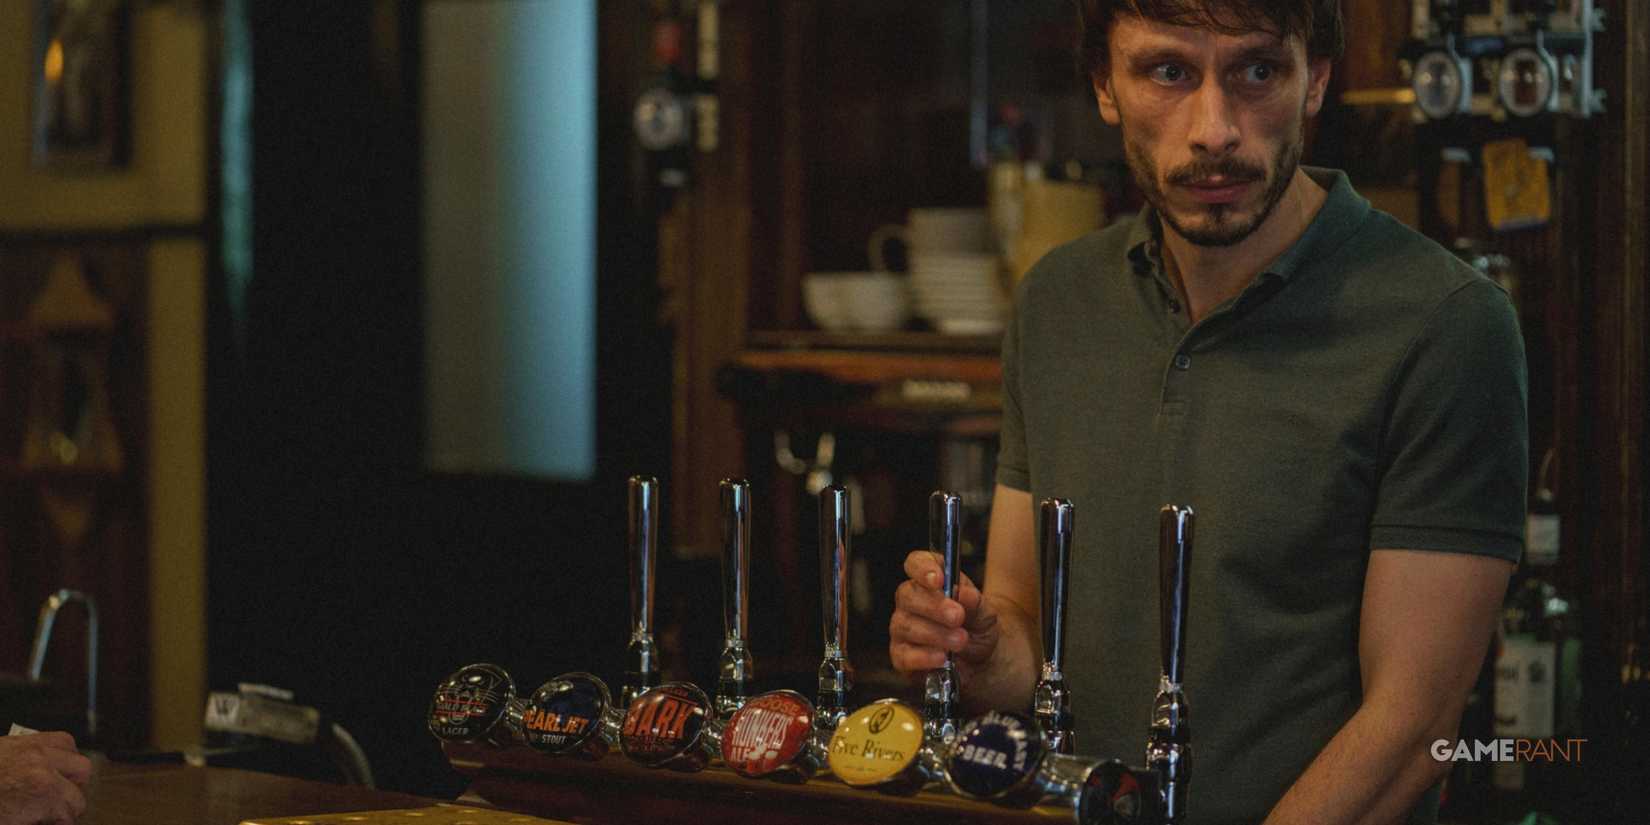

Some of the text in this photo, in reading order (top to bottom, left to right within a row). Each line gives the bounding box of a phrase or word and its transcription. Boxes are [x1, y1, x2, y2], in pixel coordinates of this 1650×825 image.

[561, 715, 590, 734] JET
[542, 734, 566, 745] STOUT
[963, 744, 1007, 771] BEER
